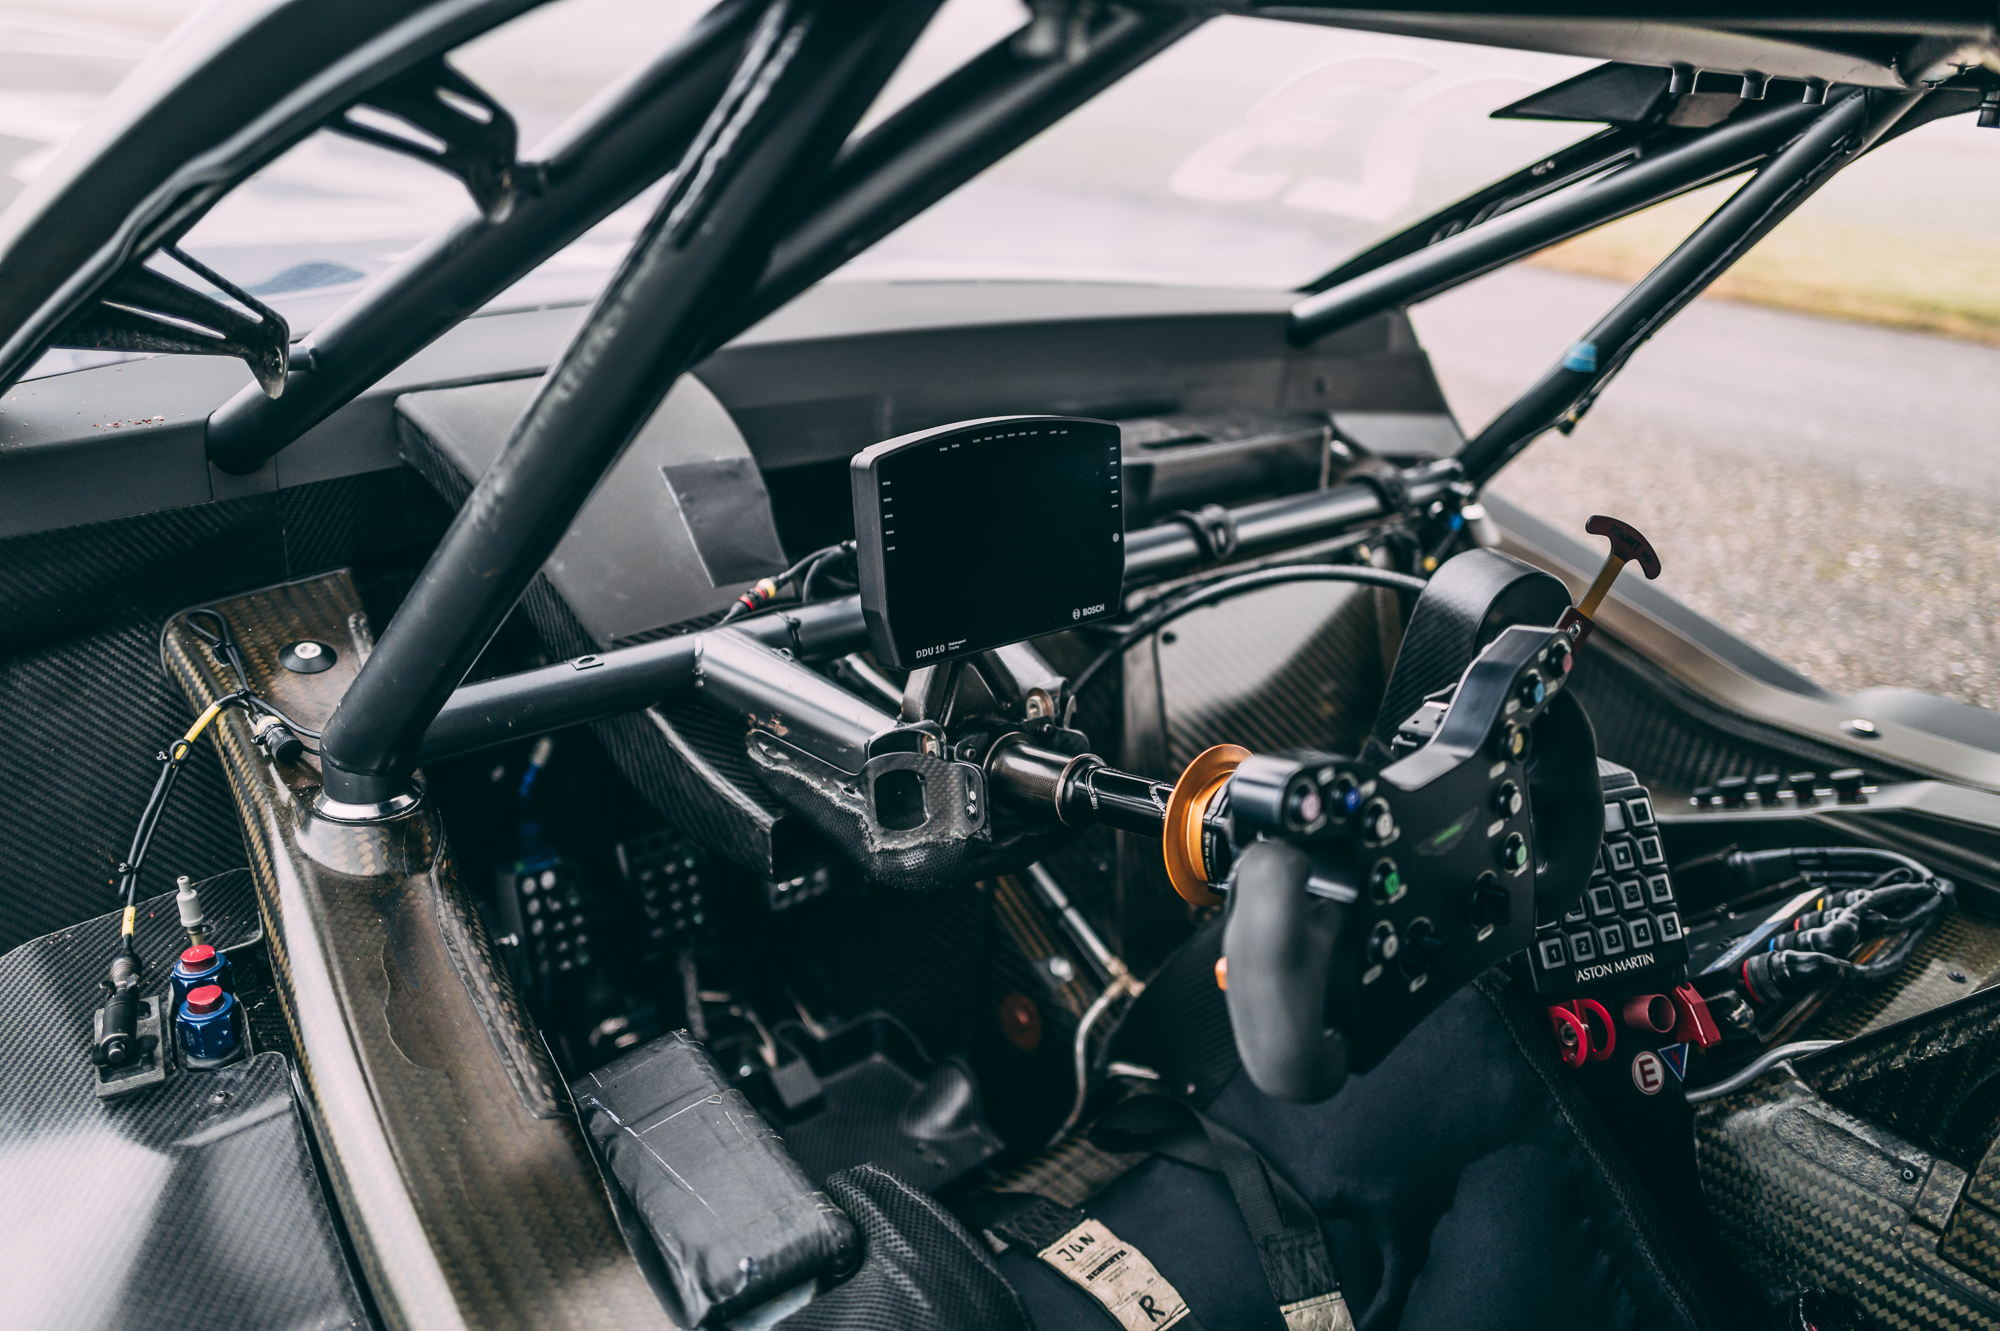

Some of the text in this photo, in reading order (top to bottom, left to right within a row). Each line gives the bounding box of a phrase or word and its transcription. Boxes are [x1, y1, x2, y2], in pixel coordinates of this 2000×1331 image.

[1608, 524, 1642, 551] FRONT
[1083, 604, 1105, 616] BOSCH
[916, 644, 945, 659] DDU 10
[1551, 921, 1674, 959] 1 2 3 4 5
[1577, 952, 1655, 983] ASTON MARTIN
[1638, 1058, 1659, 1088] E
[1138, 1294, 1165, 1322] R
